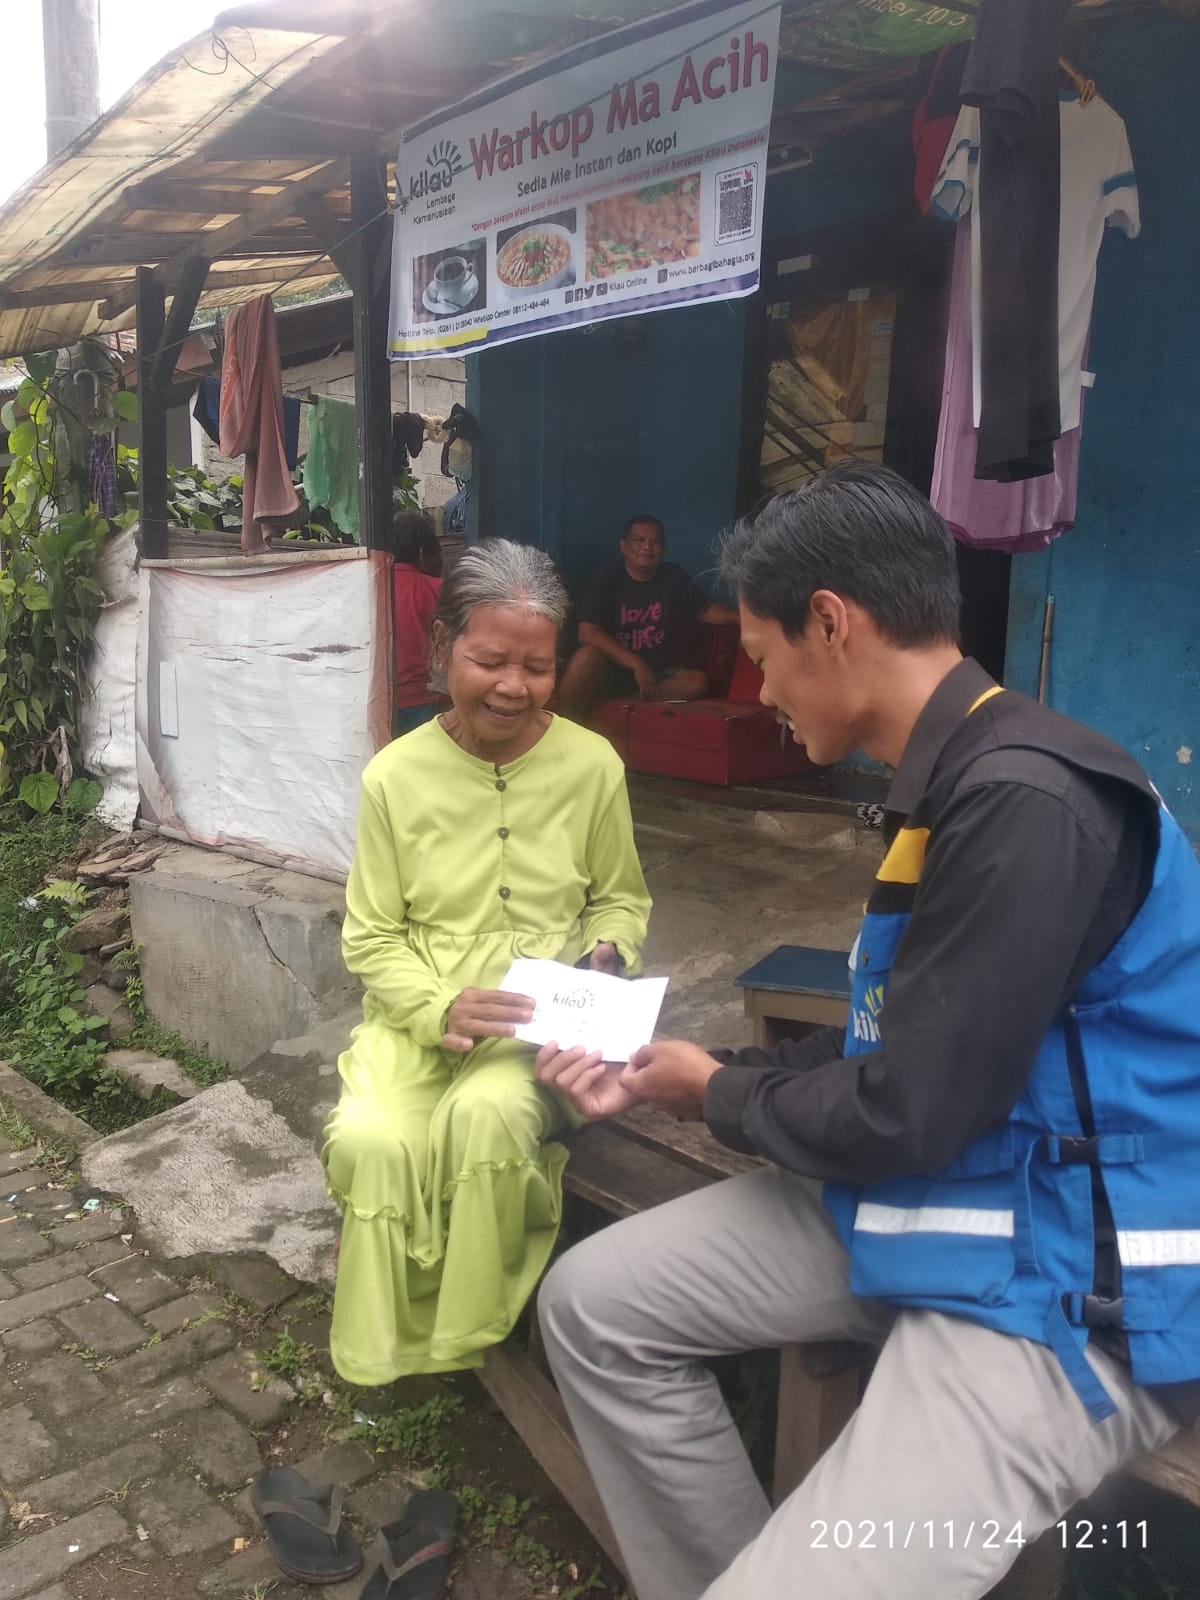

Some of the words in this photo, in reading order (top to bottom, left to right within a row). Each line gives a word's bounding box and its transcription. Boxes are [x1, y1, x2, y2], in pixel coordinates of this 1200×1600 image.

[469, 104, 594, 181] Warkop
[606, 78, 661, 134] Ma
[671, 32, 769, 112] Acih
[517, 175, 547, 198] Sedia
[550, 167, 571, 187] Mie
[575, 154, 613, 180] Instan
[617, 147, 641, 165] dan
[646, 131, 677, 156] Kopi
[409, 163, 453, 200] kilau
[626, 276, 648, 288] Online
[620, 601, 663, 627] love
[552, 992, 587, 1009] kilau
